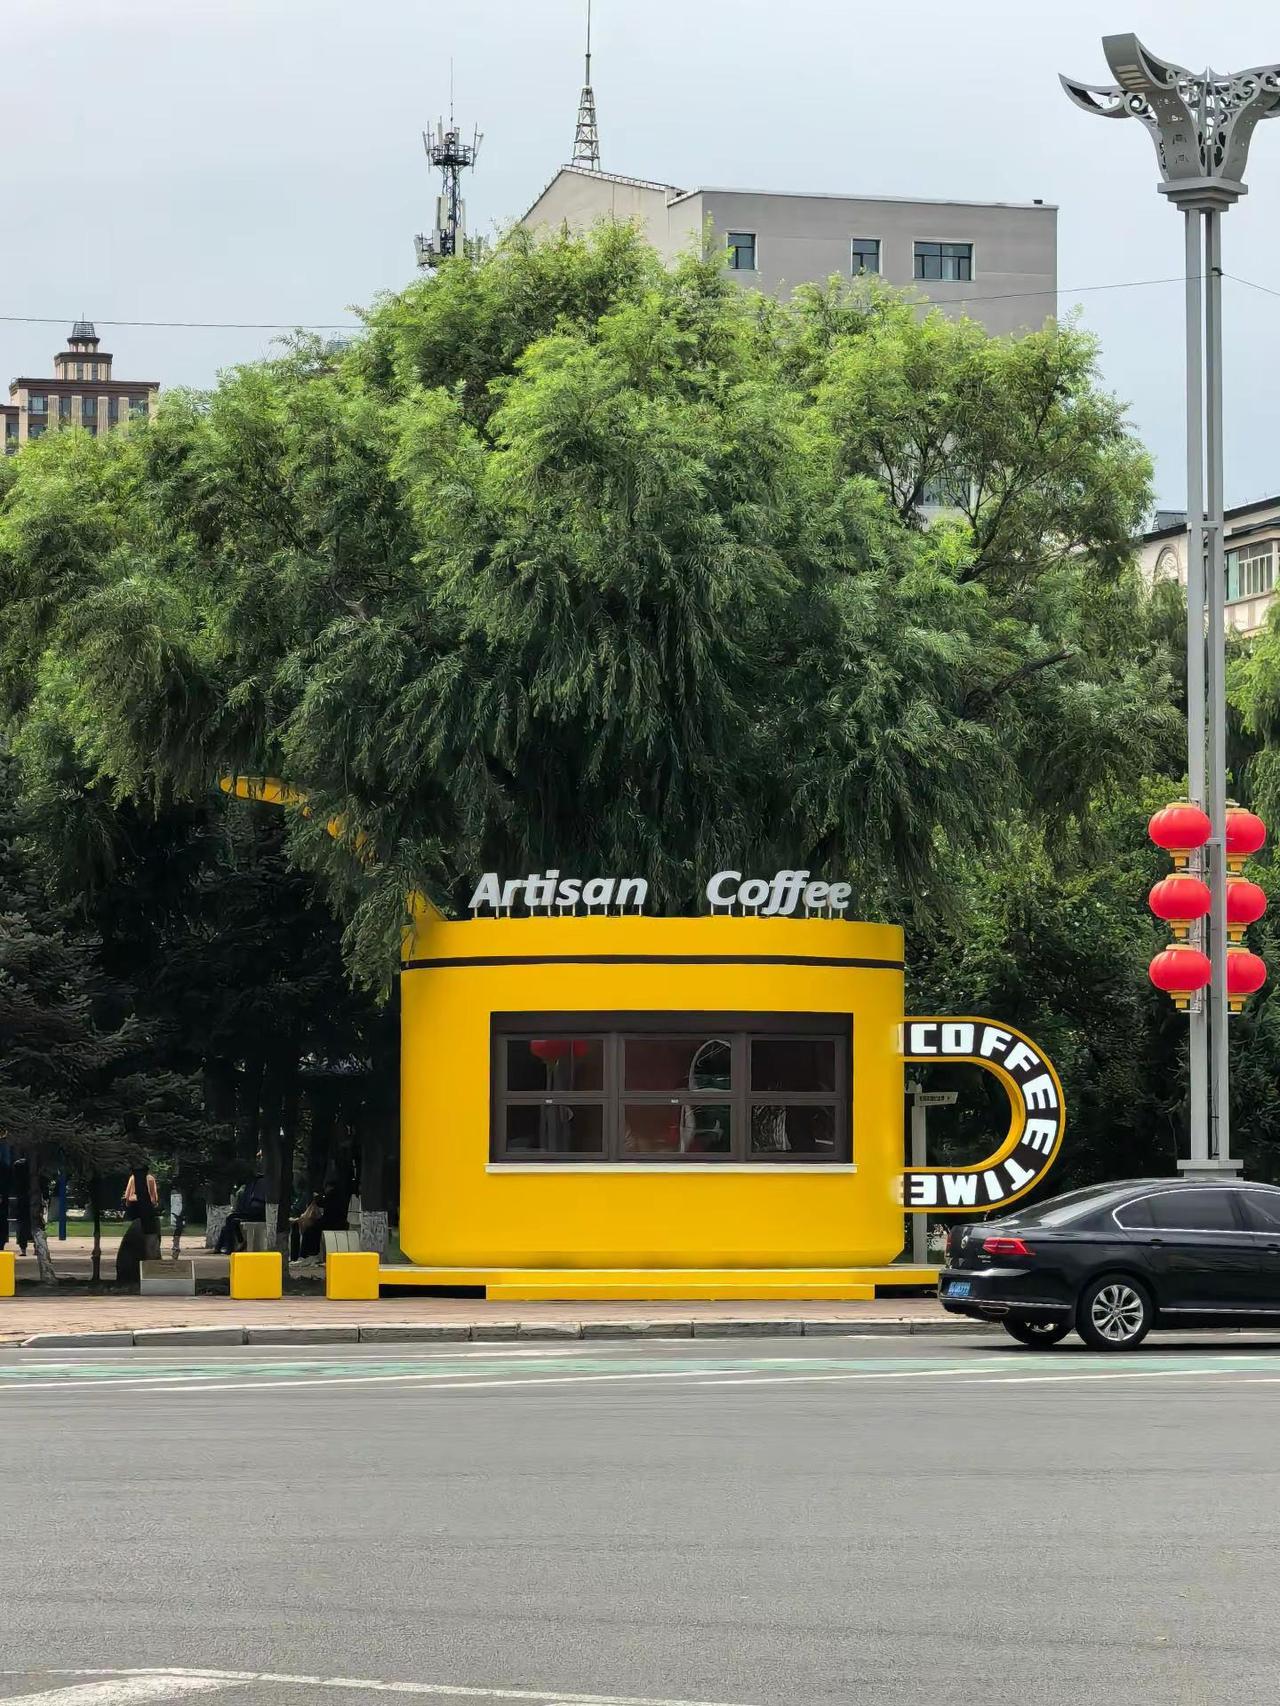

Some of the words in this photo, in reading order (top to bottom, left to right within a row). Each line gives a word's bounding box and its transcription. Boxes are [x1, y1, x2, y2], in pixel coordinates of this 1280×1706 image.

[468, 869, 648, 908] Artisan
[706, 870, 852, 915] Coffee
[910, 1023, 1058, 1156] COFFEE
[910, 1158, 1036, 1206] TIME
